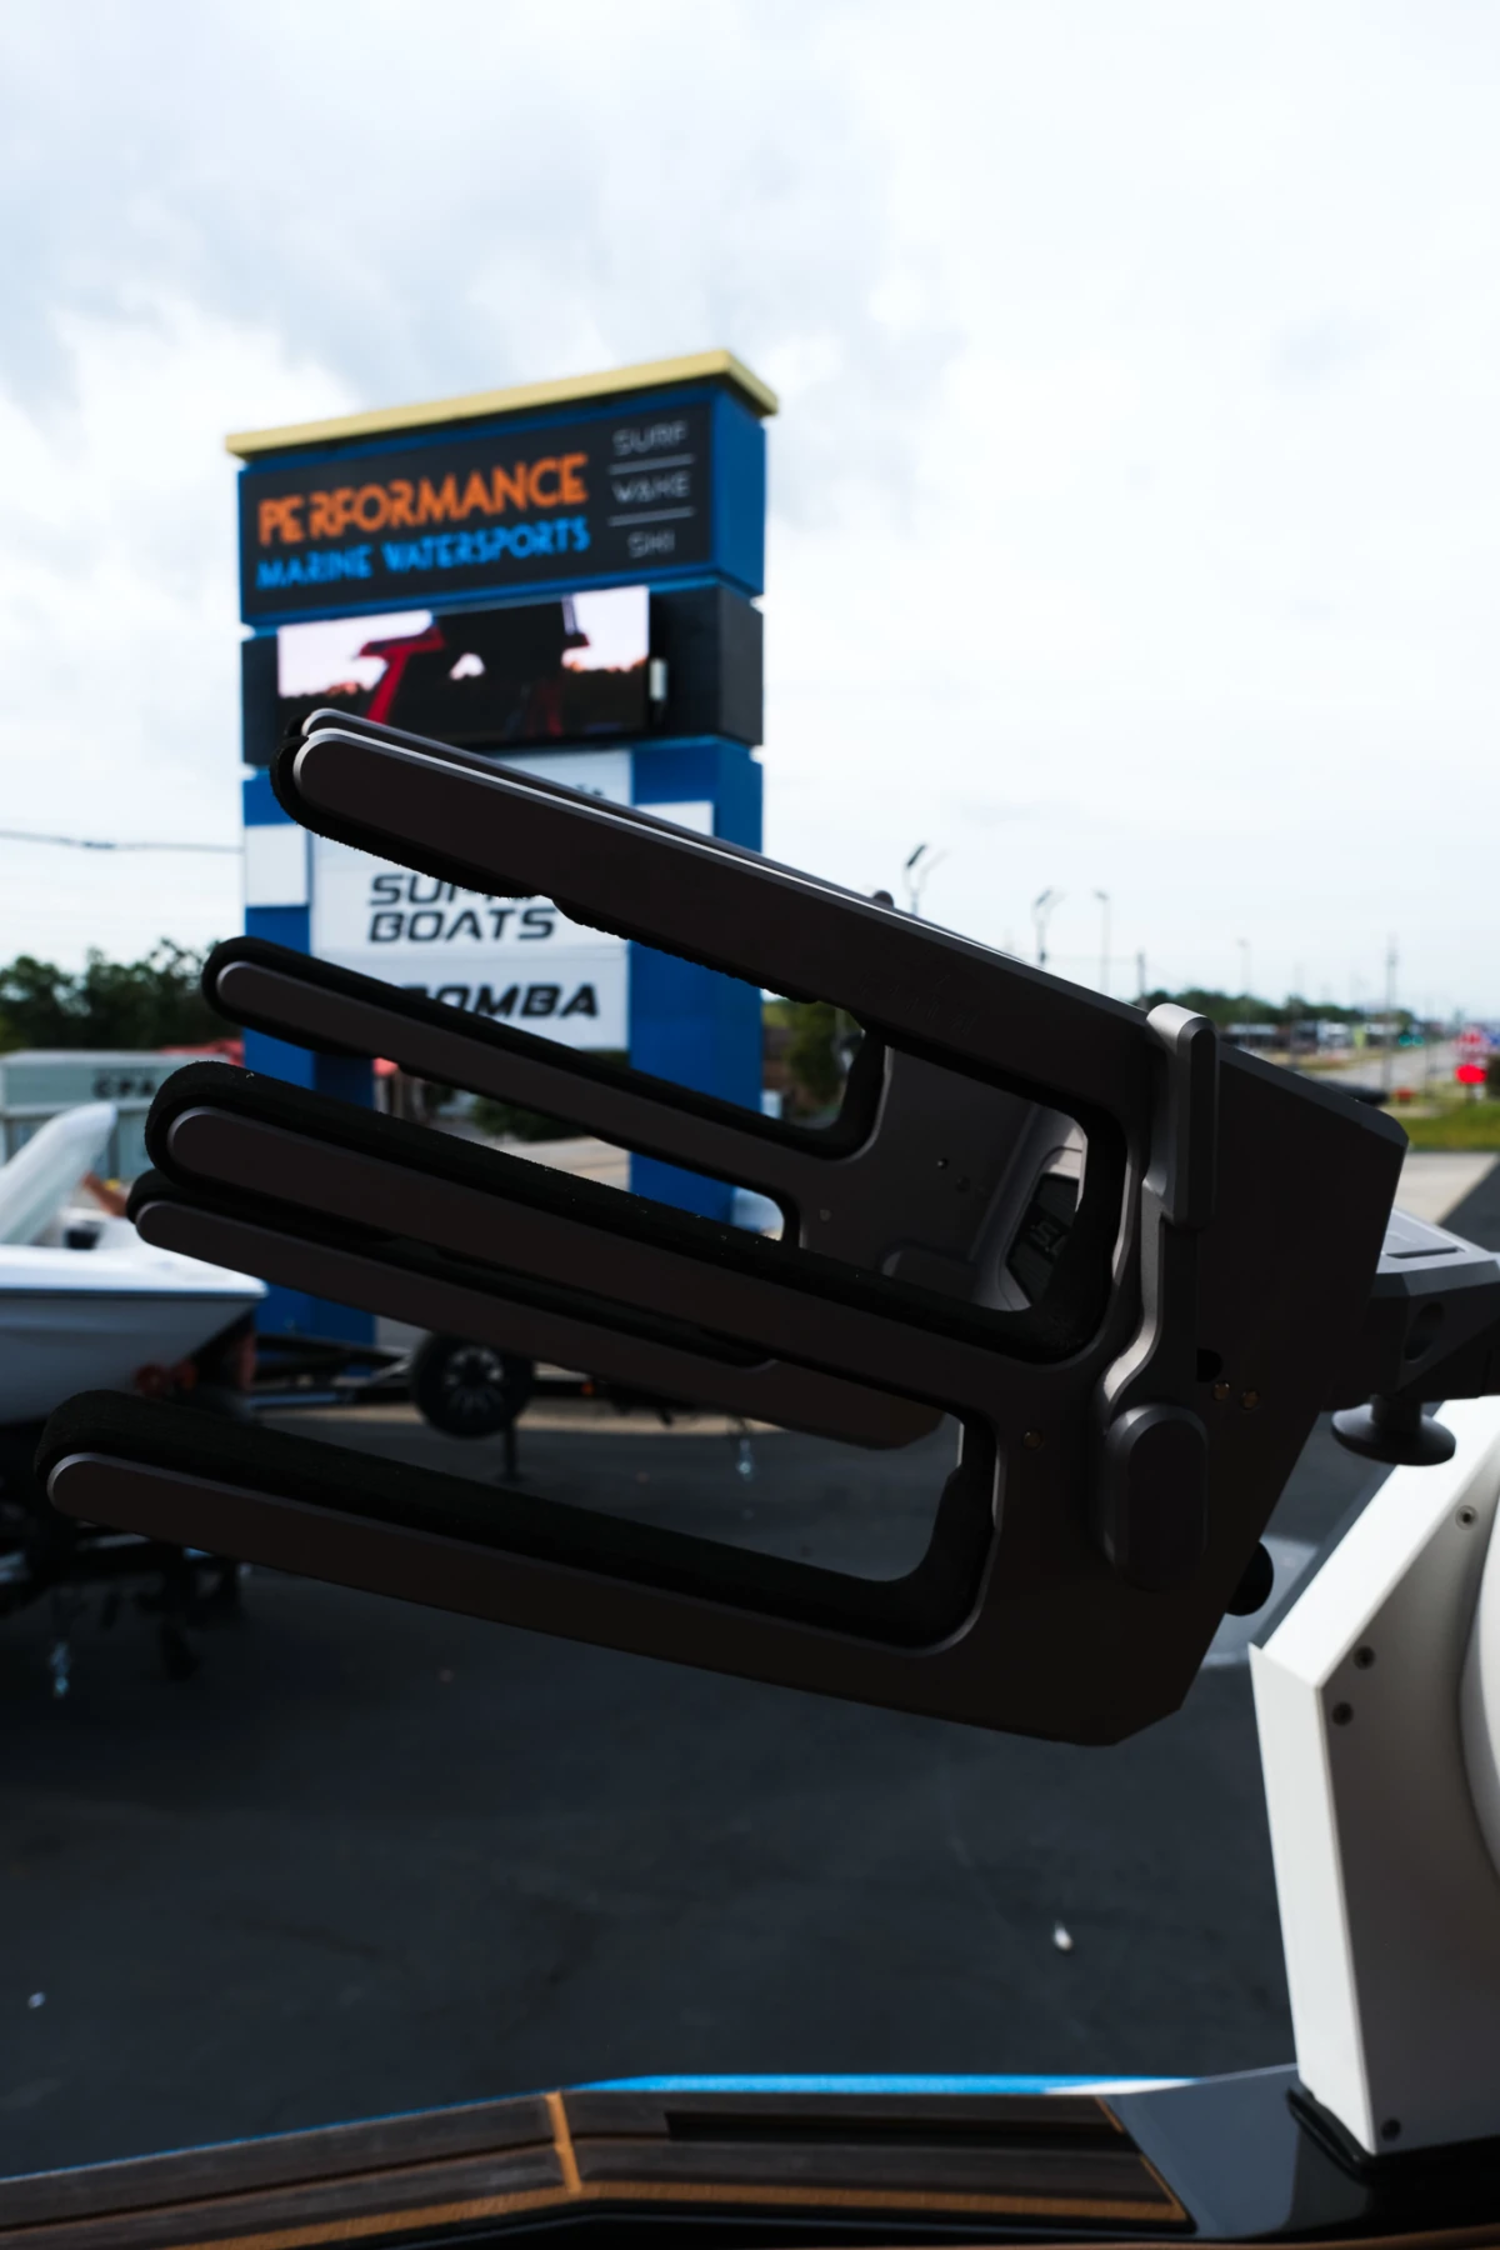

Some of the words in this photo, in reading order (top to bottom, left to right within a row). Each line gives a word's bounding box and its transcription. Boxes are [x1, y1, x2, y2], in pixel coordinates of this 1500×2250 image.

[612, 419, 688, 457] SURF
[258, 452, 588, 547] PERFORMANCE
[611, 470, 690, 503] WAKE
[255, 543, 372, 590] MARINE
[381, 515, 590, 573] WATERSPORTS
[369, 906, 557, 943] BOATS
